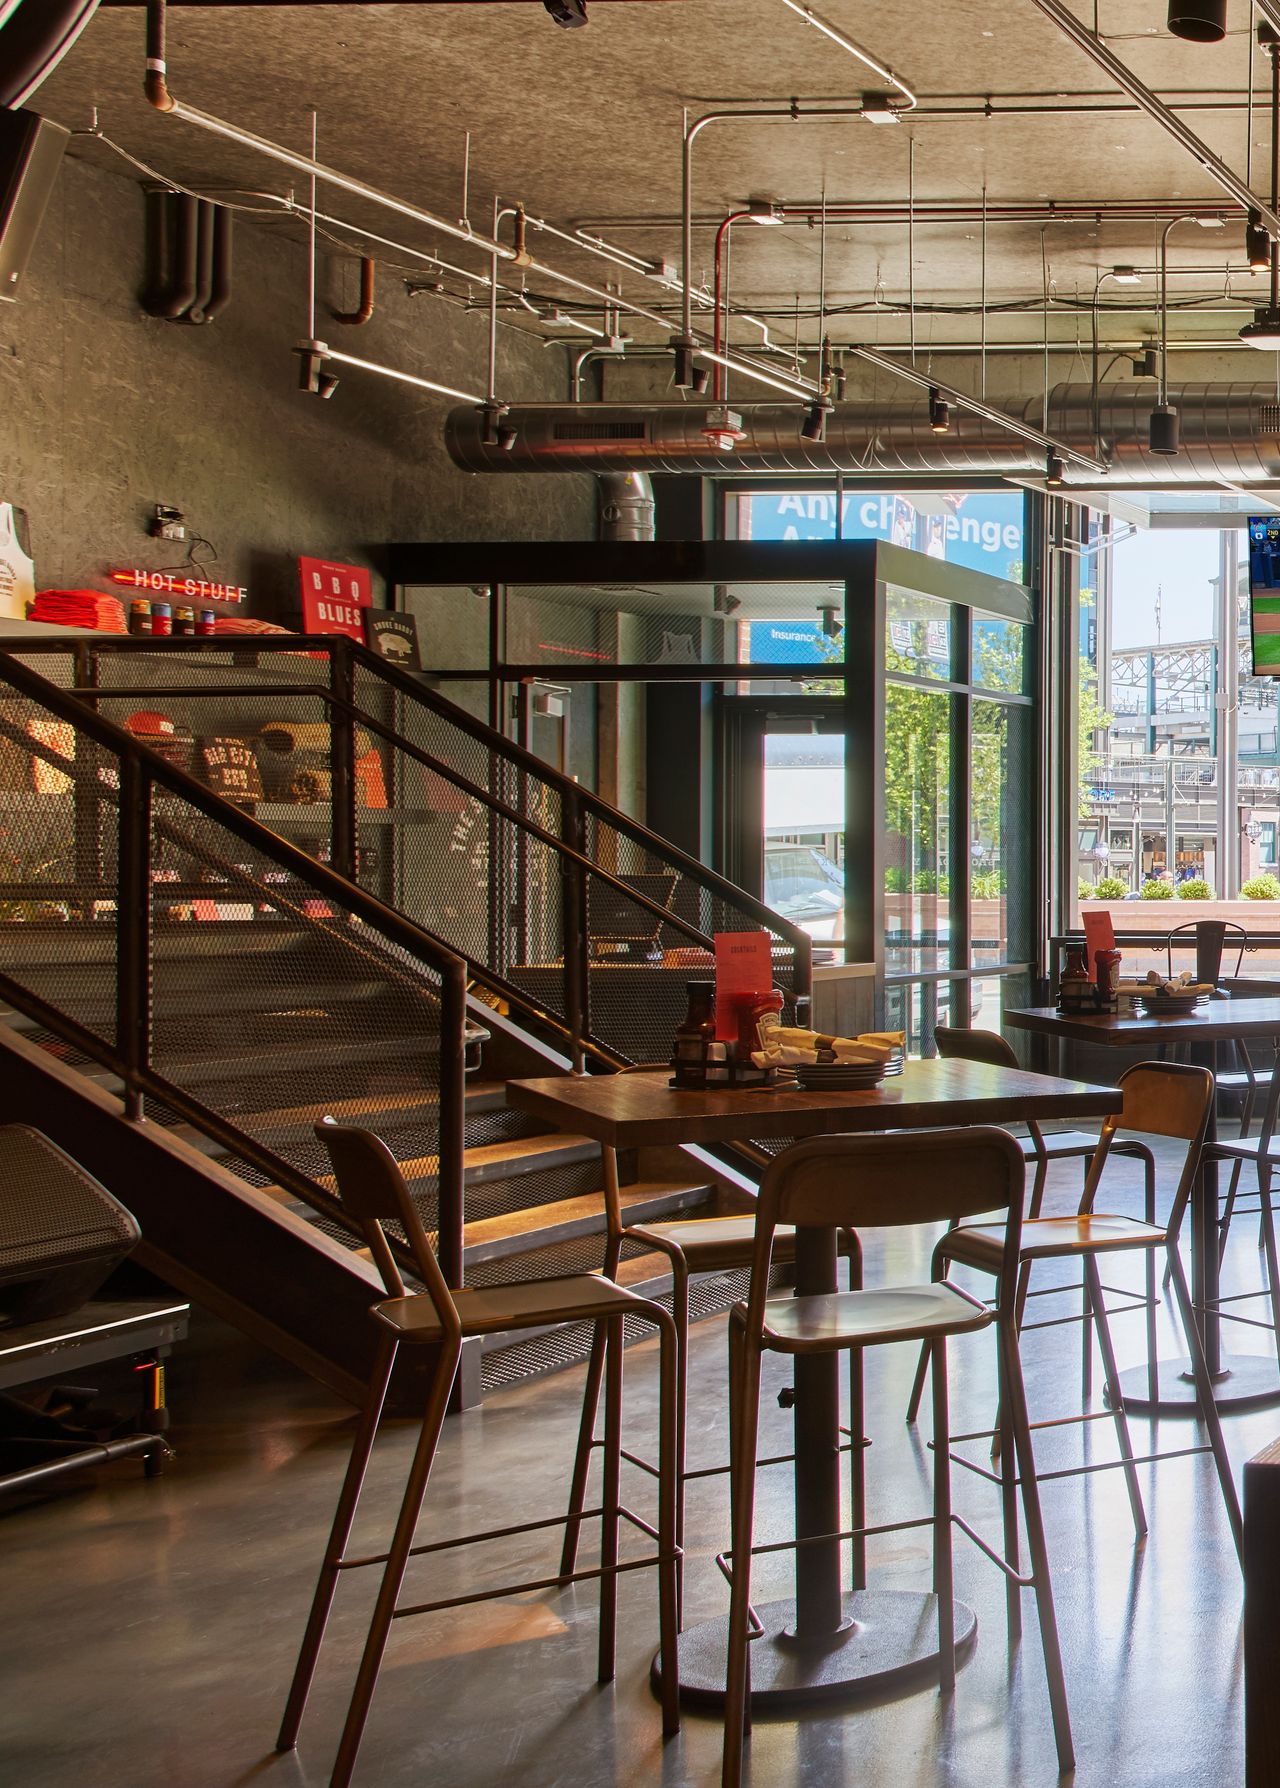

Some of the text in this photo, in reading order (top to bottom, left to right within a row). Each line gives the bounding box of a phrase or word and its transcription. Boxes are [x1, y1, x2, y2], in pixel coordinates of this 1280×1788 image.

[860, 494, 1020, 552] chenge
[134, 569, 248, 604] HOT STUFF
[317, 601, 361, 627] BLUES
[771, 628, 817, 644] Insurance
